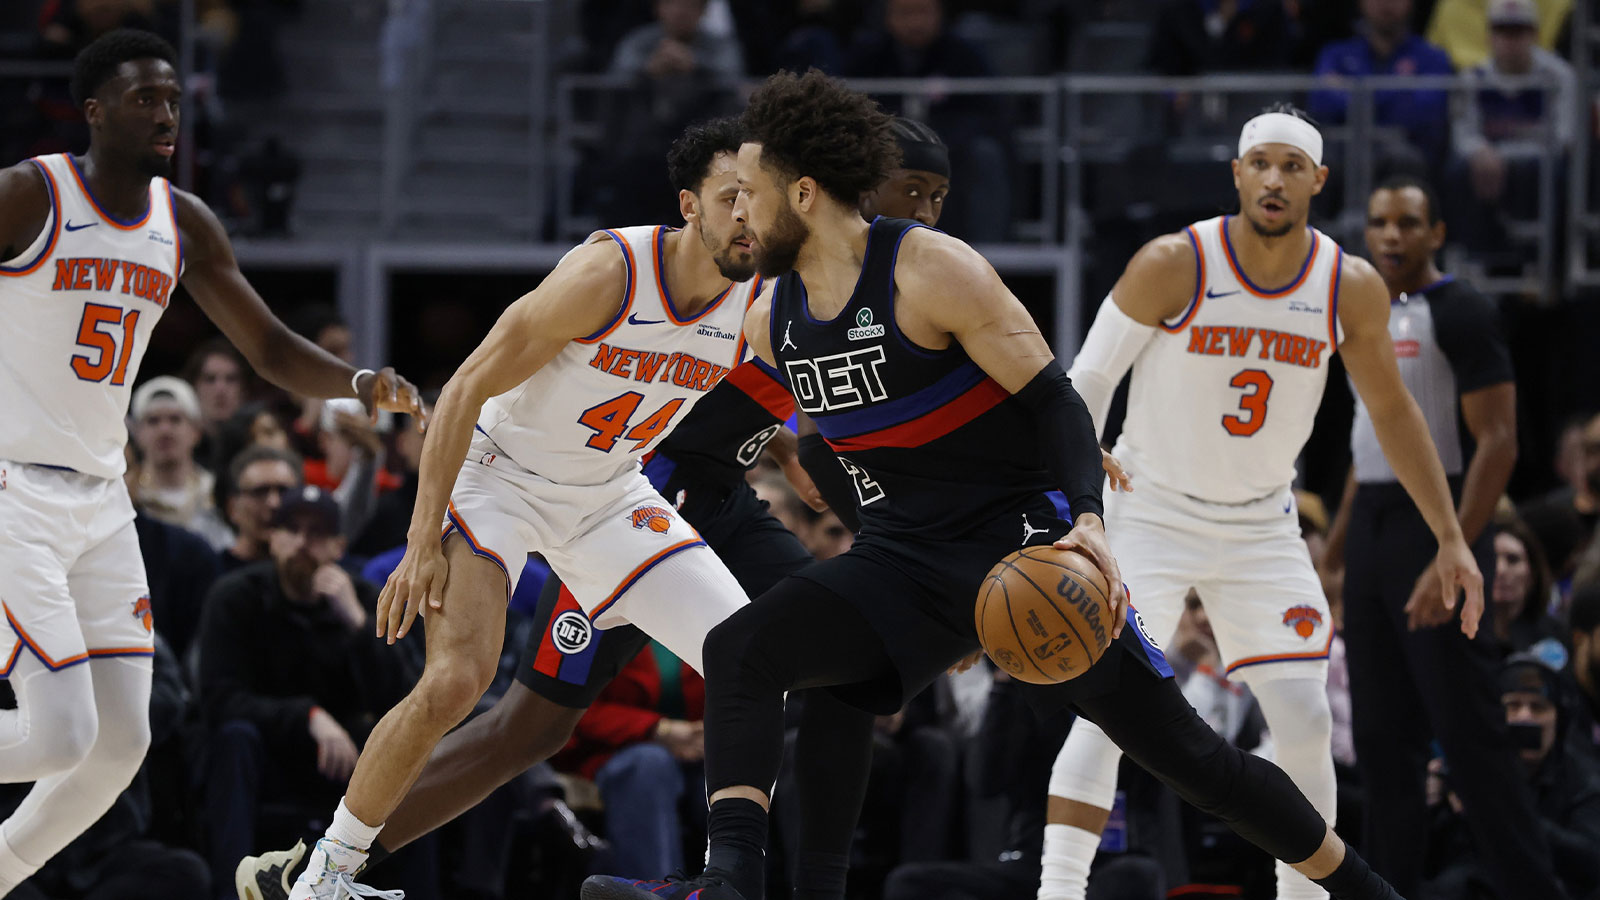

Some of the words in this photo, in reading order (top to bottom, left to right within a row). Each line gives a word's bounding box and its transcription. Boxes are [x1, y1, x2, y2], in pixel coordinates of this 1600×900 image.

[52, 258, 118, 291] NEW
[120, 261, 173, 308] YORK
[70, 302, 141, 386] 51
[696, 328, 712, 337] abu
[713, 330, 737, 341] dhabi
[849, 326, 883, 339] StockX
[1187, 326, 1256, 357] NEW
[1257, 330, 1327, 368] YORK
[589, 342, 668, 384] NEW
[658, 352, 731, 392] YORK
[785, 344, 888, 413] DET
[577, 390, 687, 454] 44
[1221, 368, 1274, 437] 3
[736, 423, 781, 467] 8
[837, 456, 886, 507] 2
[632, 506, 676, 528] KNIC
[559, 621, 586, 644] DET
[1057, 573, 1107, 654] Wilson
